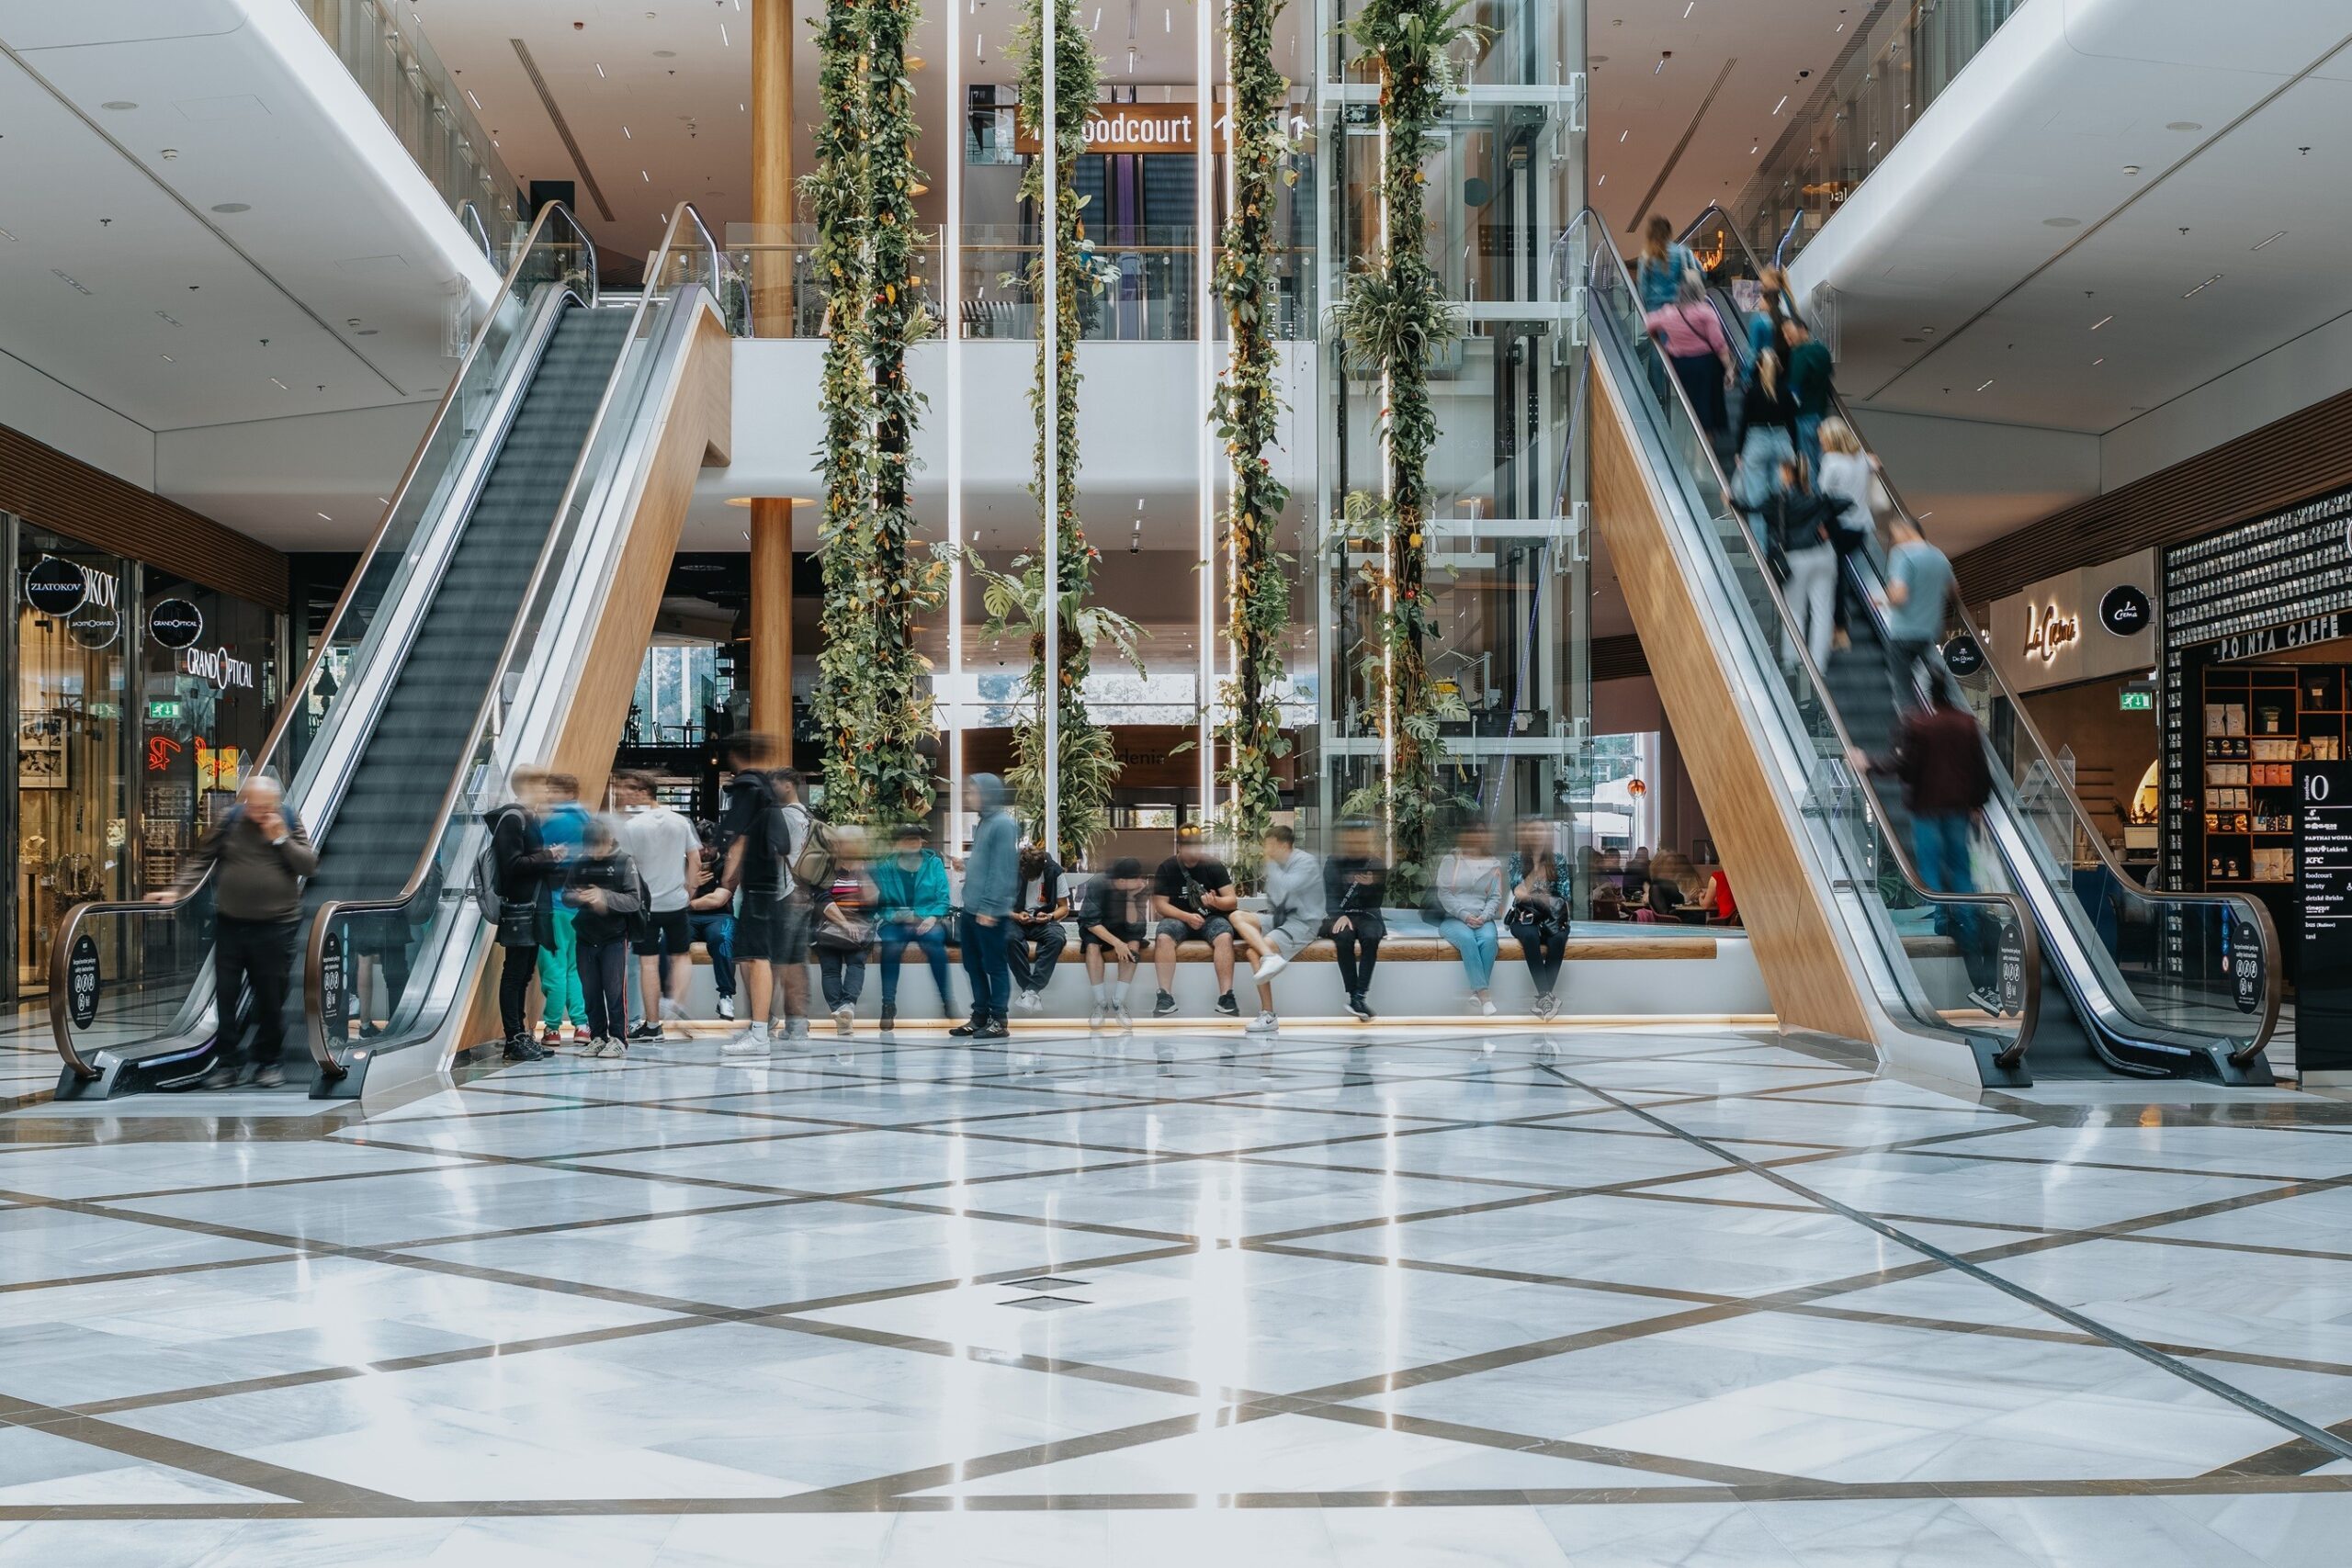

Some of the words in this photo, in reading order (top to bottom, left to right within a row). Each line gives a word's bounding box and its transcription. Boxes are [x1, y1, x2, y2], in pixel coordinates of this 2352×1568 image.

[1081, 112, 1192, 142] oodcourt
[30, 582, 81, 591] ZLATOKOV
[2125, 601, 2137, 612] La
[2114, 609, 2138, 621] Crema
[153, 619, 198, 627] GRANDOPTICAL
[2287, 615, 2339, 647] CAFFE
[187, 647, 254, 690] GRANDOPTICAL
[1115, 748, 1165, 765] denia
[2311, 775, 2329, 800] 0
[2305, 856, 2324, 864] KFC
